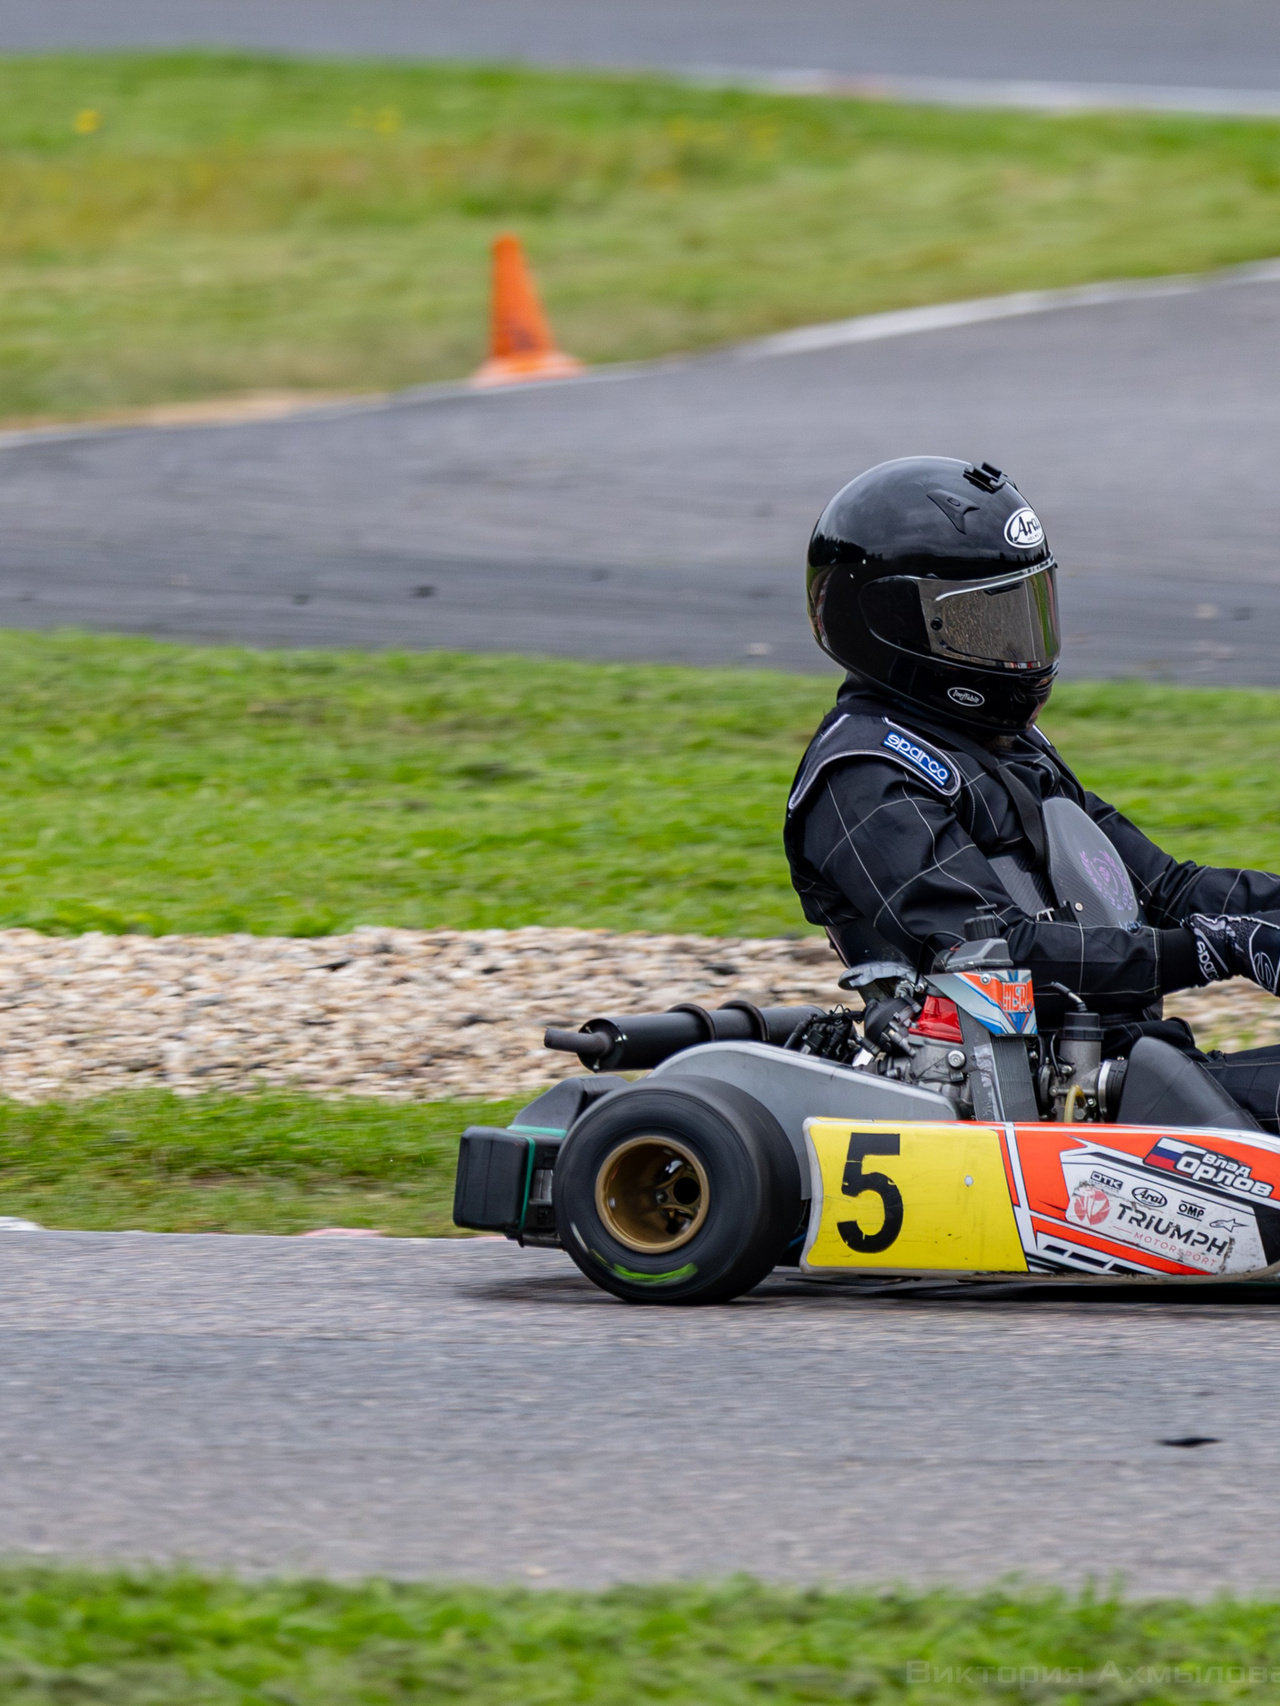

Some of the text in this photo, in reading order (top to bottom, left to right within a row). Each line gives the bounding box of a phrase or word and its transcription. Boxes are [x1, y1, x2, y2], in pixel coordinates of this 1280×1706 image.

[887, 734, 948, 780] sparco
[1092, 1172, 1122, 1190] OTK
[1176, 1156, 1273, 1197] Орлов
[1202, 1153, 1252, 1178] Влад
[837, 1132, 903, 1254] 5
[1133, 1188, 1166, 1206] Arai
[1178, 1203, 1205, 1218] OMP
[1117, 1203, 1228, 1256] TRIUMPH
[1134, 1231, 1217, 1267] MOTORSPORT
